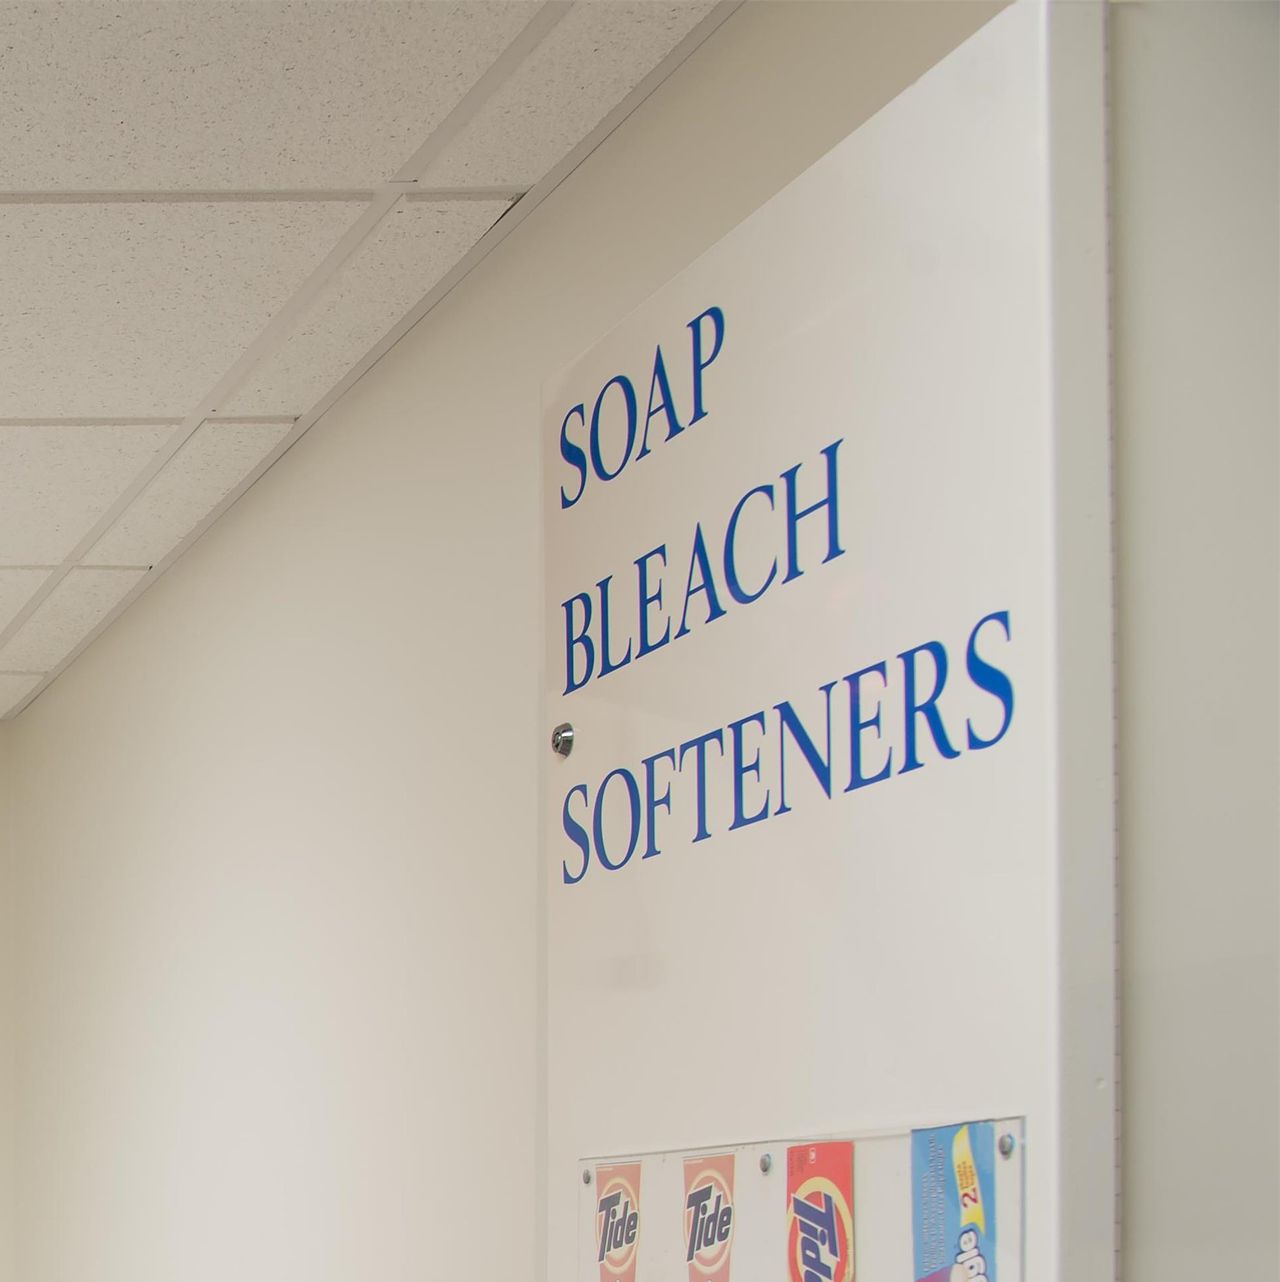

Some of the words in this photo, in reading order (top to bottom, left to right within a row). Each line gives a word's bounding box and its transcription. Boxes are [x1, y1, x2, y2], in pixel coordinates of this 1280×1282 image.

[559, 305, 726, 509] SOAP
[560, 437, 846, 697] BLEACH
[561, 609, 1016, 885] SOFTENERS
[598, 1190, 639, 1263] Tide
[686, 1183, 732, 1263] Tide
